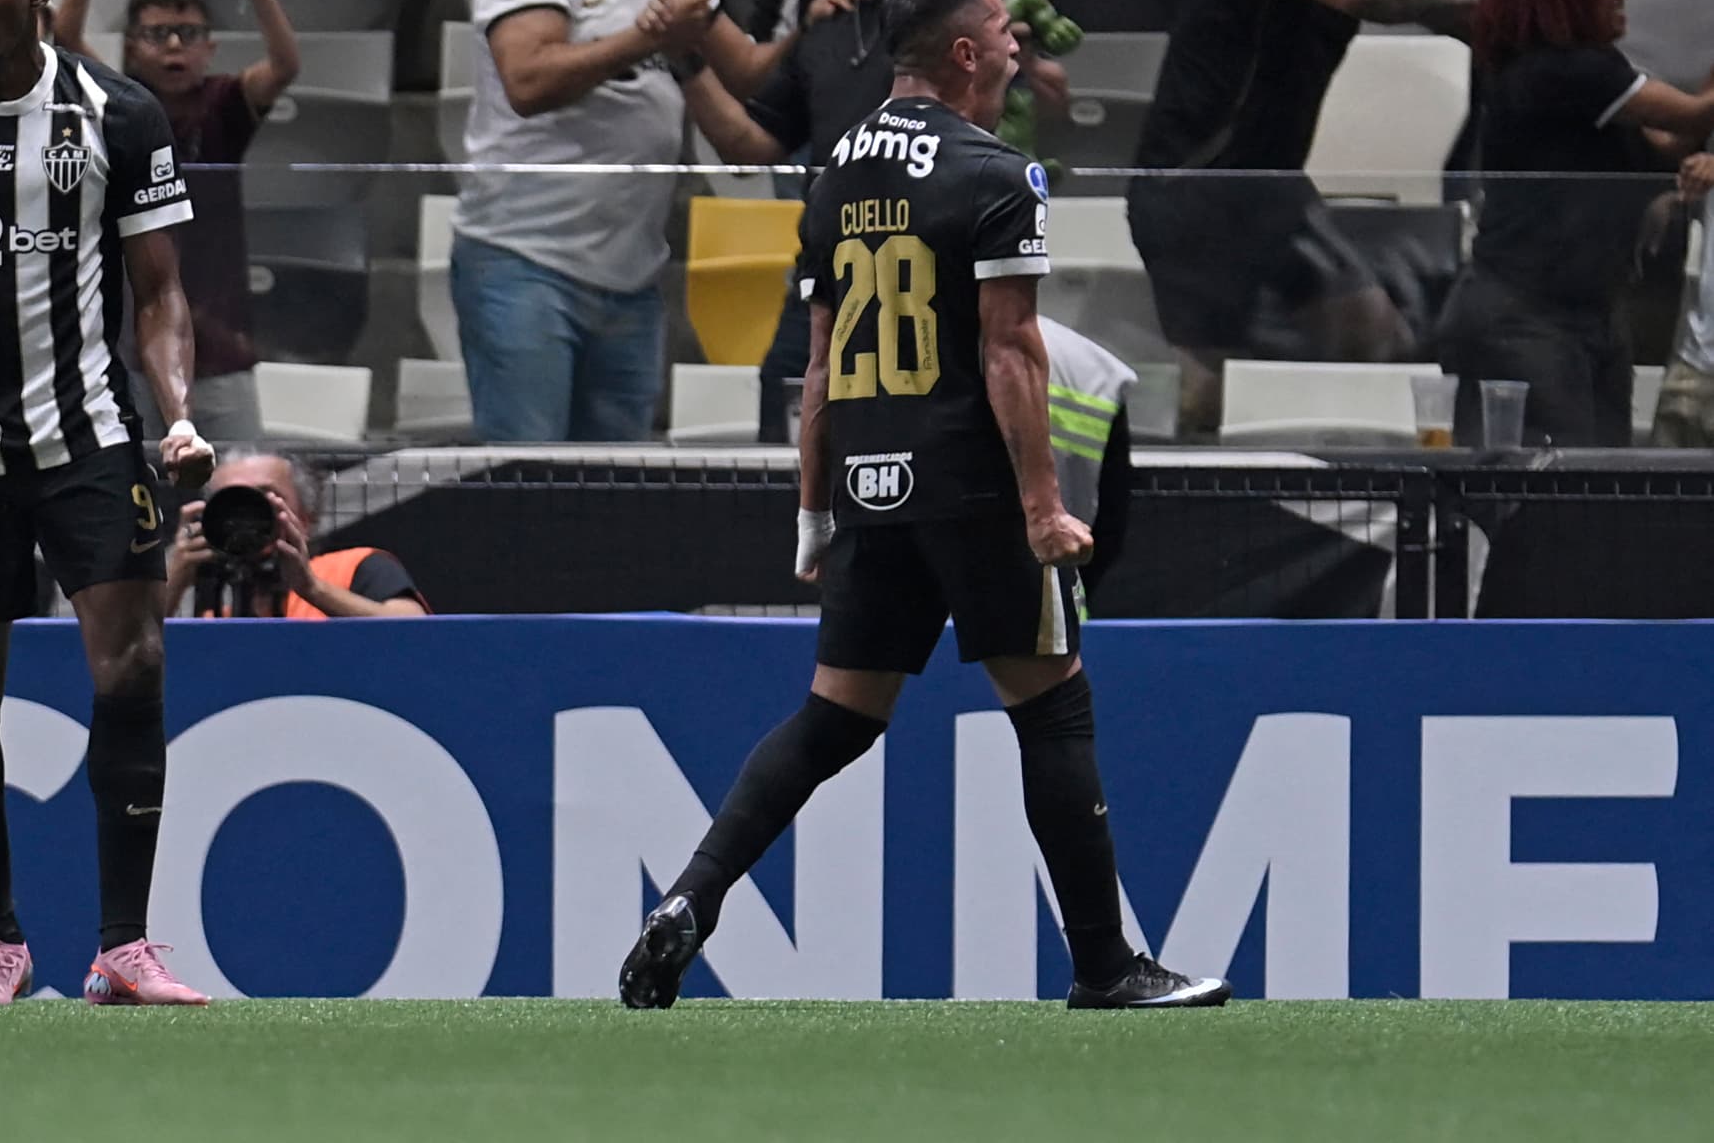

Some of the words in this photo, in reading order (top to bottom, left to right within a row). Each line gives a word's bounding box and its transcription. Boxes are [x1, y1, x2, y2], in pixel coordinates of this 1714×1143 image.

[878, 112, 927, 130] banco
[852, 124, 941, 178] bmg
[841, 198, 911, 236] CUELLO
[828, 235, 941, 402] 28
[857, 465, 901, 500] BH
[130, 482, 158, 530] 9
